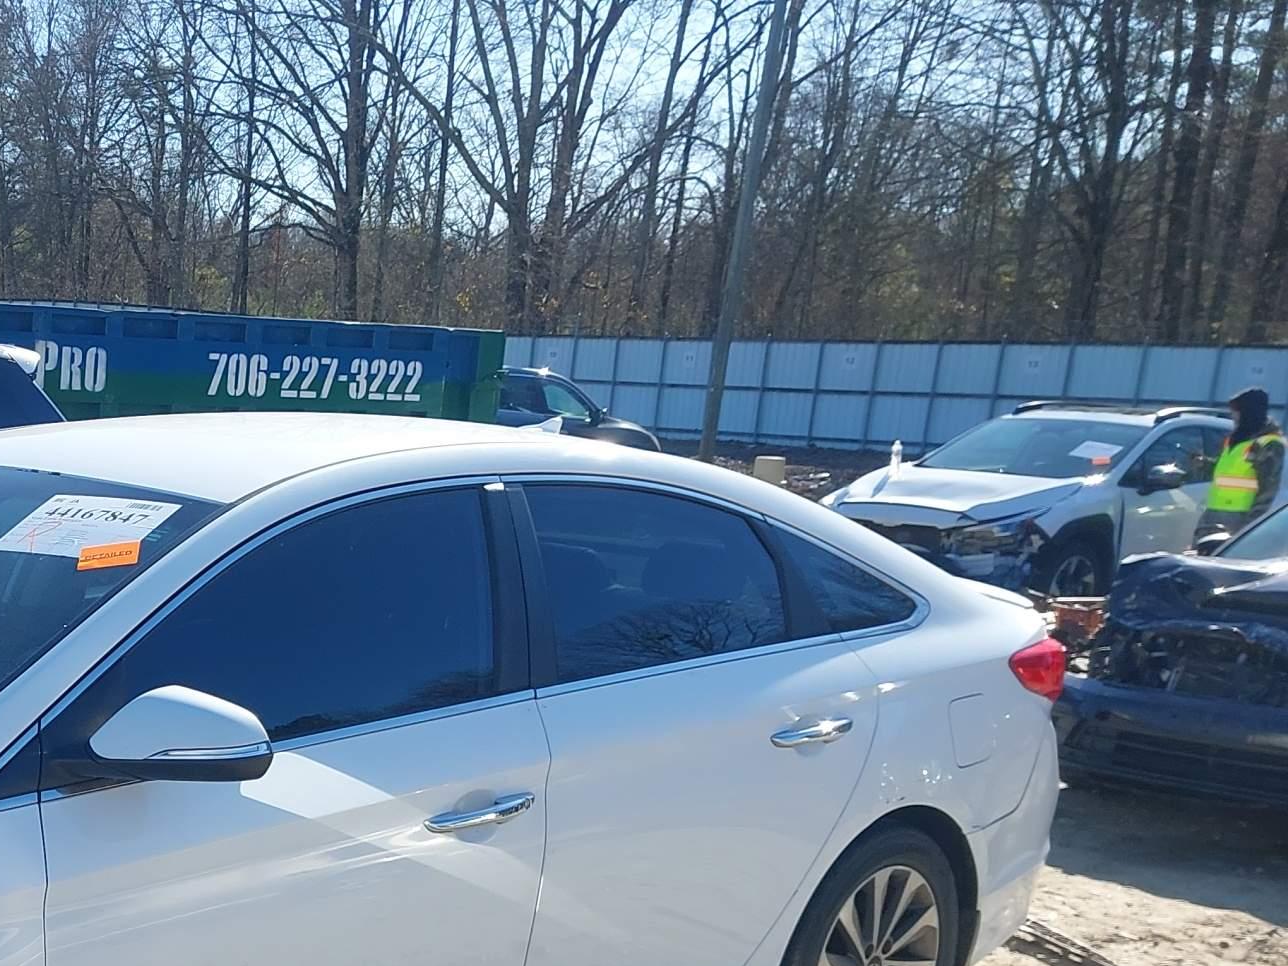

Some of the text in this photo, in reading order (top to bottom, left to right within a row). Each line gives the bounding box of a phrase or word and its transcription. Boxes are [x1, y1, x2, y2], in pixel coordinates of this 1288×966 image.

[35, 340, 107, 392] PRO
[207, 353, 423, 401] 706-227-3222
[45, 506, 150, 525] 44167847
